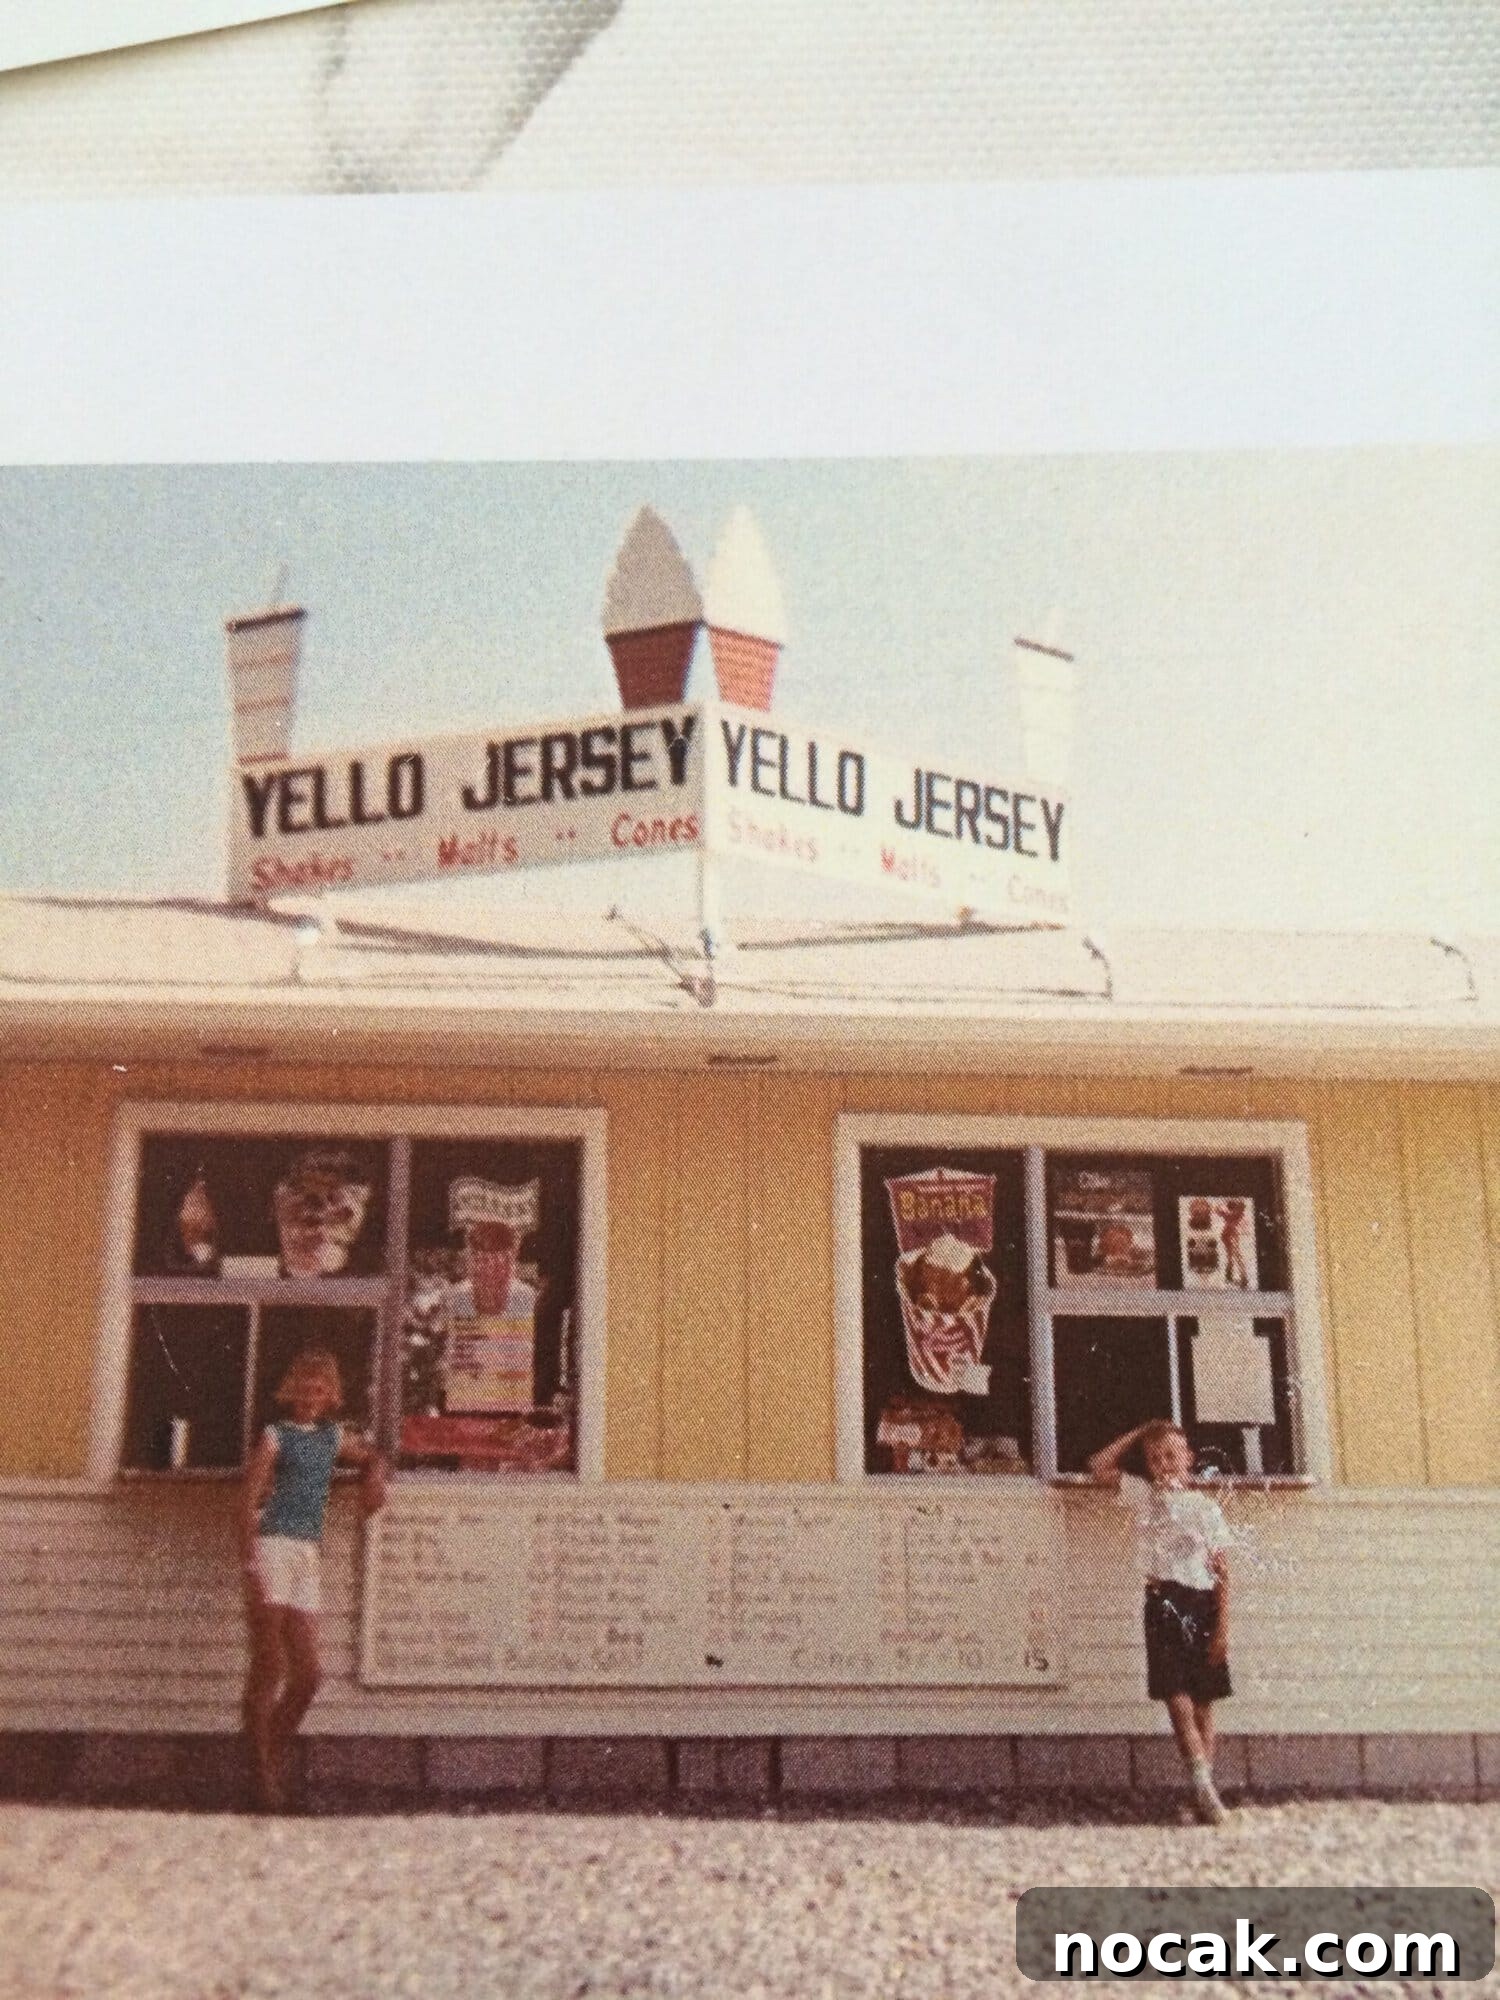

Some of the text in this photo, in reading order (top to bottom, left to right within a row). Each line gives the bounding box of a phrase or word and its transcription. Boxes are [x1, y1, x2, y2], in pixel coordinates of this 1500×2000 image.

[242, 714, 697, 839] YELLO JERSEY
[610, 811, 699, 848] Cones
[720, 718, 1065, 862] YELLO JERSEY
